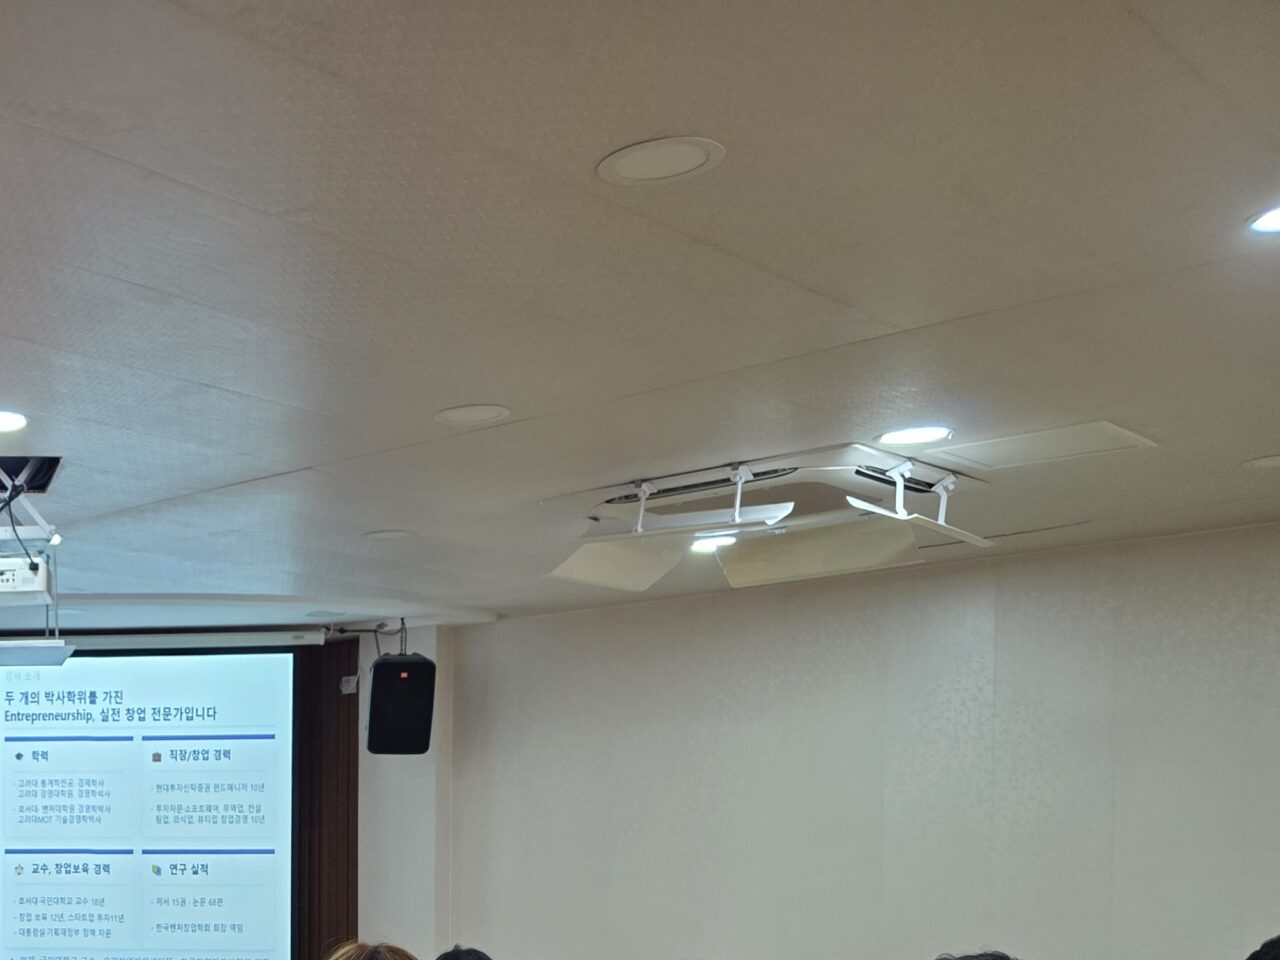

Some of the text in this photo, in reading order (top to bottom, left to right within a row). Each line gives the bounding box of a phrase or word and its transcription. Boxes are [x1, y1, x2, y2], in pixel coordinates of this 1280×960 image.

[5, 690, 124, 705] 두 개의 박사학위를 가진
[4, 706, 217, 725] Entrepreneurship, 실전 창업 전문가입니다
[31, 751, 49, 762] 학력
[169, 749, 231, 761] 직장/창업 경력
[31, 863, 111, 875] 교수, 창업보육 경력
[169, 863, 209, 875] 연구 실적
